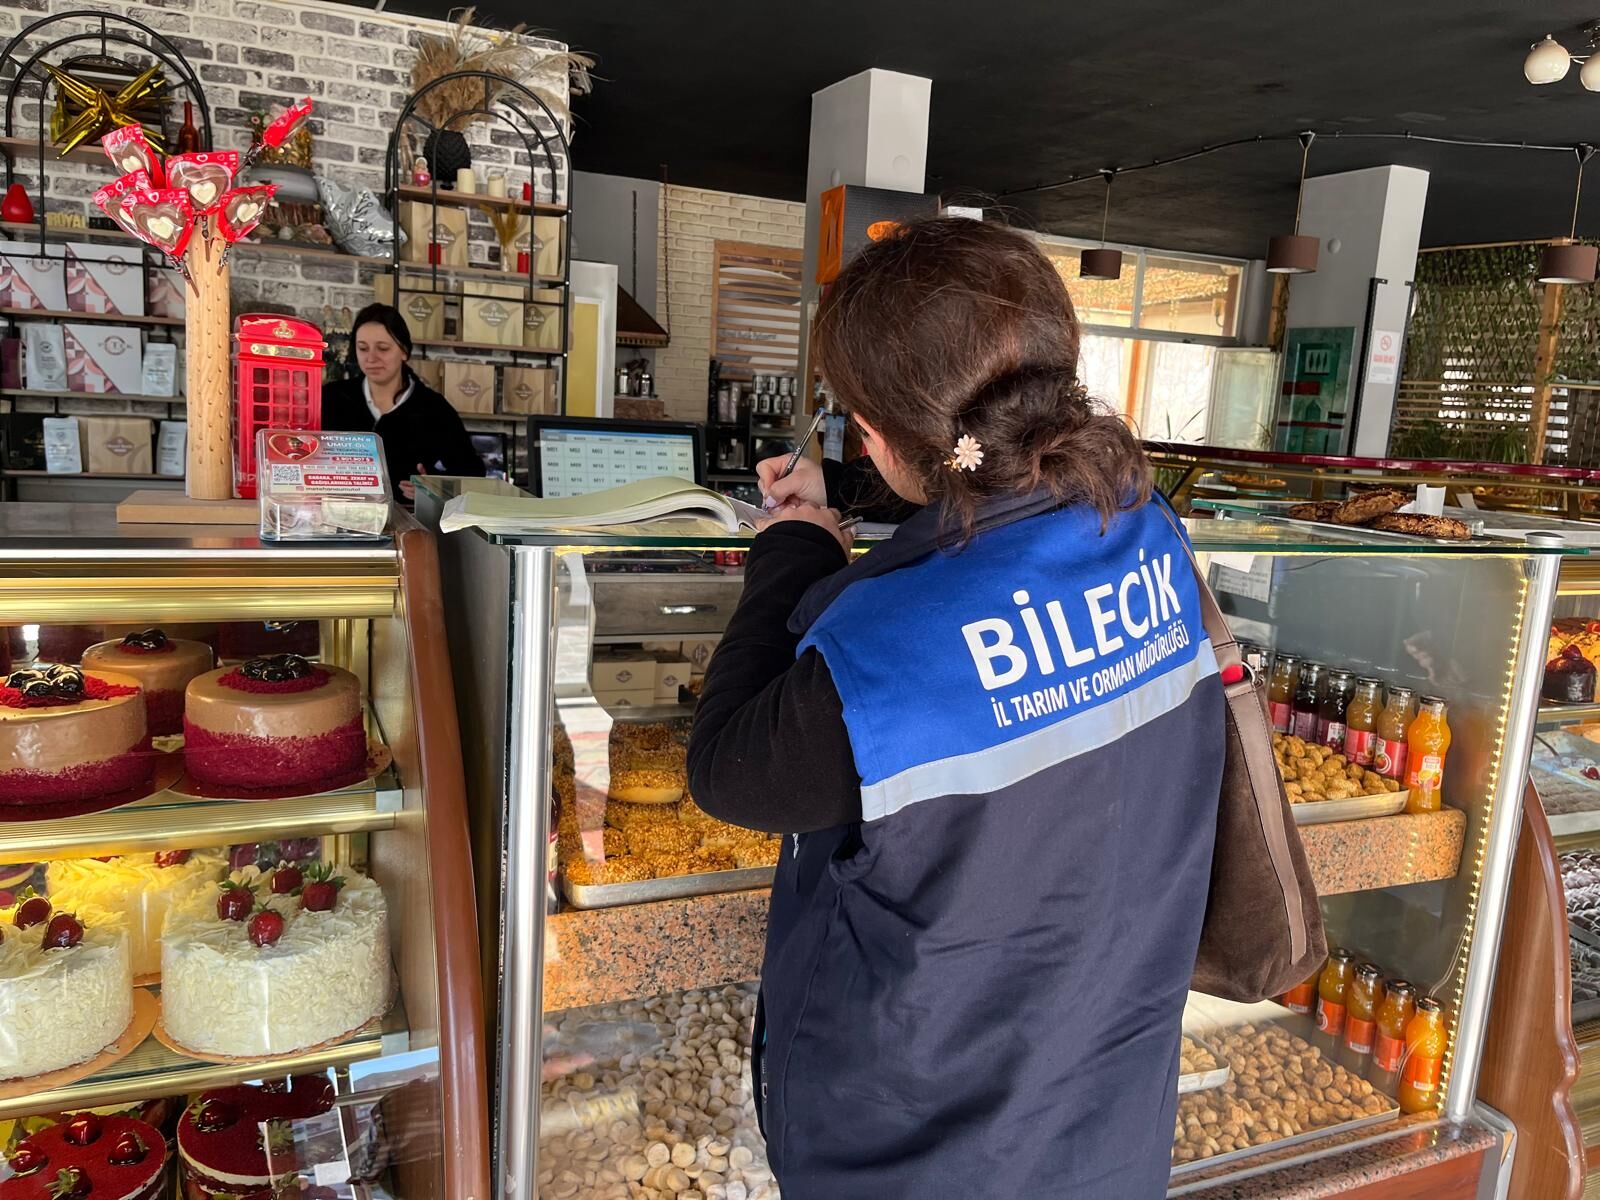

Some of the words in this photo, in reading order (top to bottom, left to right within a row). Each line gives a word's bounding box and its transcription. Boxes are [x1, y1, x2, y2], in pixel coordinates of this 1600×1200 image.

[961, 548, 1181, 691] BİLECİK
[990, 697, 1012, 728] İL
[1010, 684, 1069, 722] TARIM
[1069, 676, 1092, 705] VE
[1092, 656, 1137, 697] ORMAN
[1134, 619, 1190, 675] MÜDÜRLÜĞÜ
